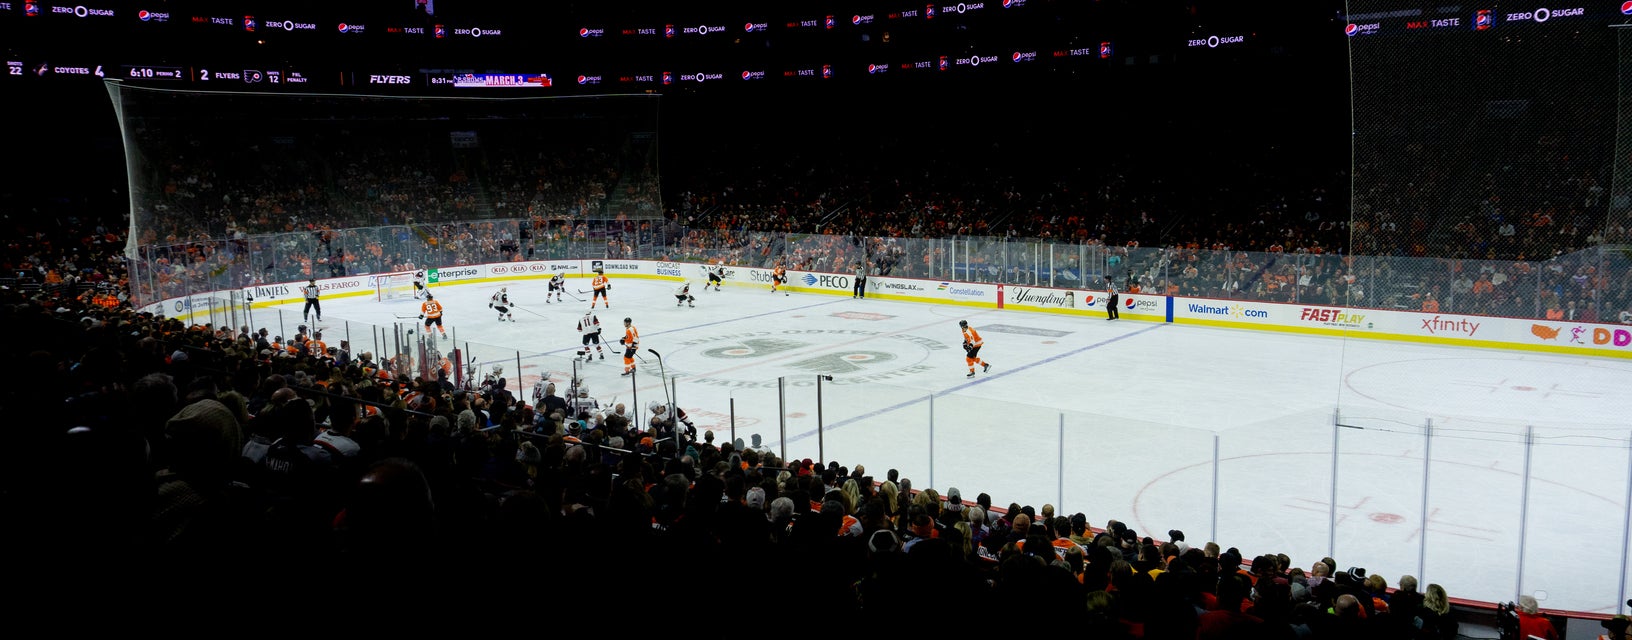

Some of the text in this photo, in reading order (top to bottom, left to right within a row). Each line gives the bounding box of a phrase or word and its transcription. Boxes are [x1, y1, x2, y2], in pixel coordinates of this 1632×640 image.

[967, 2, 984, 10] SUGAR
[52, 6, 114, 17] ZERO SUGAR
[902, 10, 918, 18] TASTE
[1506, 8, 1585, 22] ZERO SUGAR
[211, 17, 233, 26] TASTE
[266, 20, 284, 28] ZERO
[1431, 17, 1460, 28] TASTE
[1358, 22, 1380, 32] pepsi
[1188, 35, 1244, 47] ZERO SUGAR
[1070, 48, 1090, 56] TASTE
[915, 61, 931, 69] TASTE
[9, 66, 23, 76] 22
[54, 65, 105, 78] COYOTES 4
[130, 68, 153, 78] 6:10
[200, 69, 240, 81] 2 FLYERS
[268, 75, 279, 83] 12
[370, 74, 411, 84] FLYERS
[485, 75, 517, 85] MARCH
[517, 75, 524, 85] 3
[656, 261, 681, 269] COMCAST
[432, 267, 477, 281] enterprise
[656, 268, 682, 277] BUSINESS
[331, 280, 360, 289] FARGO
[820, 274, 849, 289] PECO
[255, 284, 289, 298] DANIEL'S
[949, 287, 985, 297] Constellation
[1011, 286, 1065, 307] Yuengling
[426, 303, 438, 313] 93
[1137, 299, 1158, 309] pepsi
[1188, 303, 1268, 318] Walmart com
[583, 318, 591, 328] 11
[1421, 315, 1480, 336] xfinity
